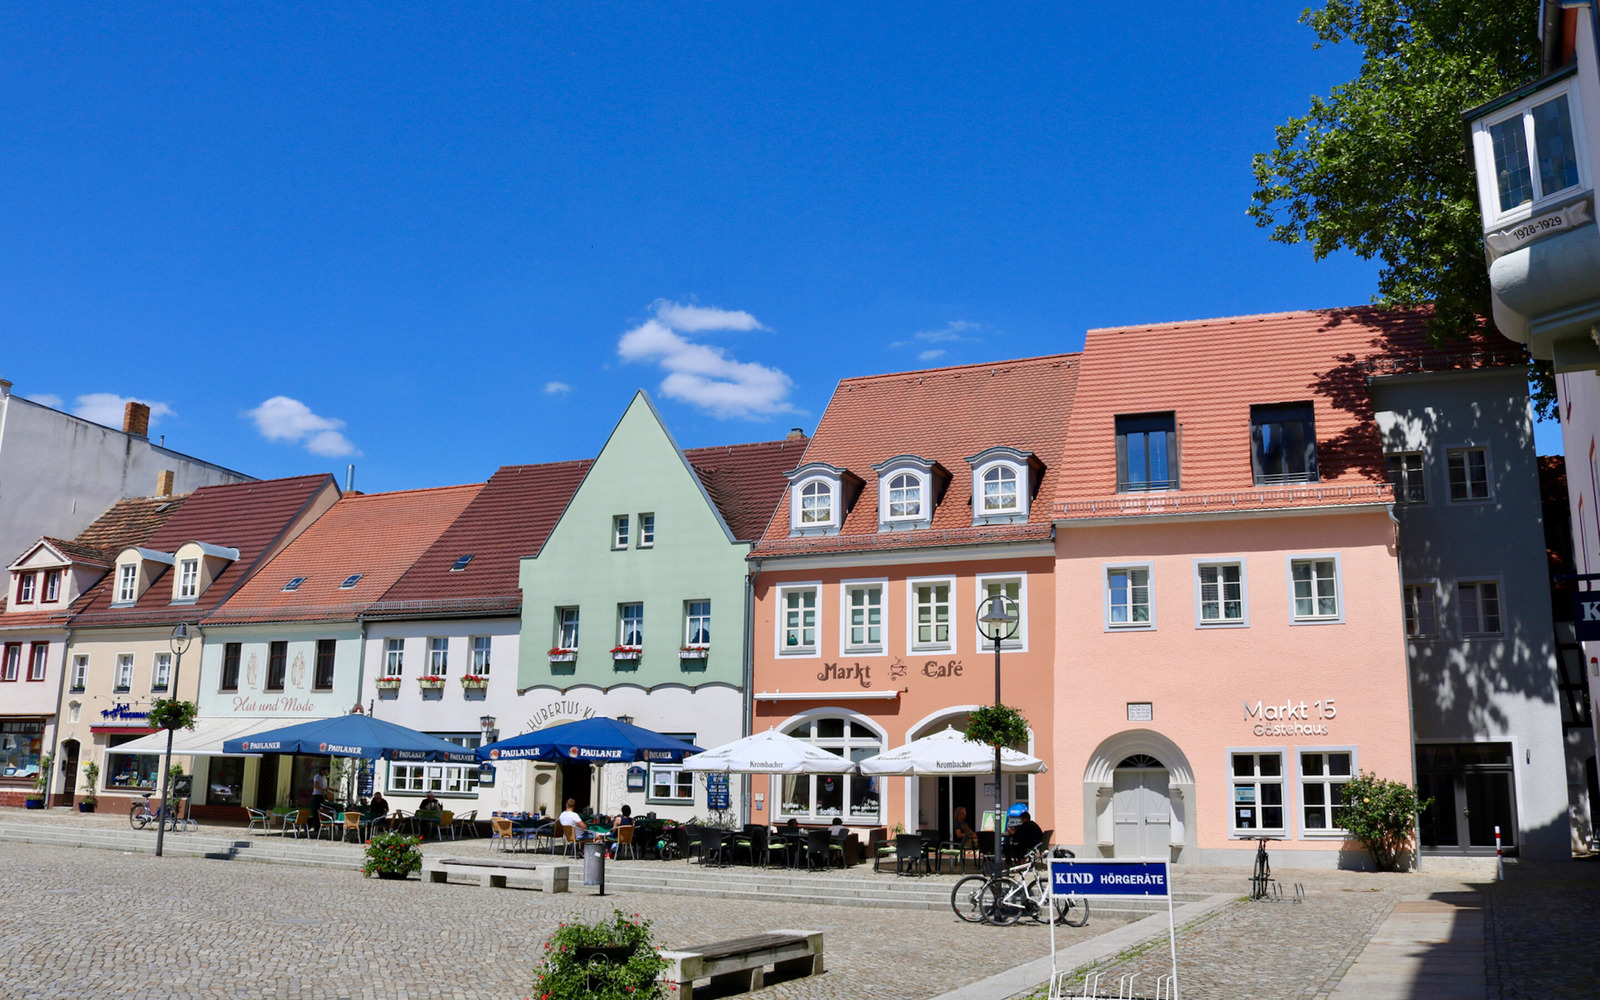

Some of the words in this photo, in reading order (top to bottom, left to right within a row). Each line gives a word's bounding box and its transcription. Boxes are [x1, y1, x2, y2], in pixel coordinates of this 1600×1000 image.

[1513, 216, 1562, 240] 1928-1929
[817, 663, 871, 688] Markt
[921, 660, 963, 679] Café
[232, 695, 257, 712] Hut
[258, 697, 280, 712] und
[281, 696, 315, 712] Mode
[526, 700, 580, 731] HUBERTUS
[1243, 699, 1308, 721] Markt
[1314, 699, 1336, 720] 15
[1253, 721, 1328, 737] Gästehaus
[250, 741, 281, 750] PAULANER
[327, 744, 362, 755] PAULANER
[399, 750, 426, 759] PAULANER
[450, 753, 475, 762] PAULANER
[500, 747, 541, 758] PAULANER
[580, 748, 622, 759] PAULANER
[749, 760, 784, 769] Krombacher
[936, 760, 972, 769] Krombacher
[1055, 872, 1094, 885] KIND
[1100, 872, 1165, 885] HÖRGERÄTE
